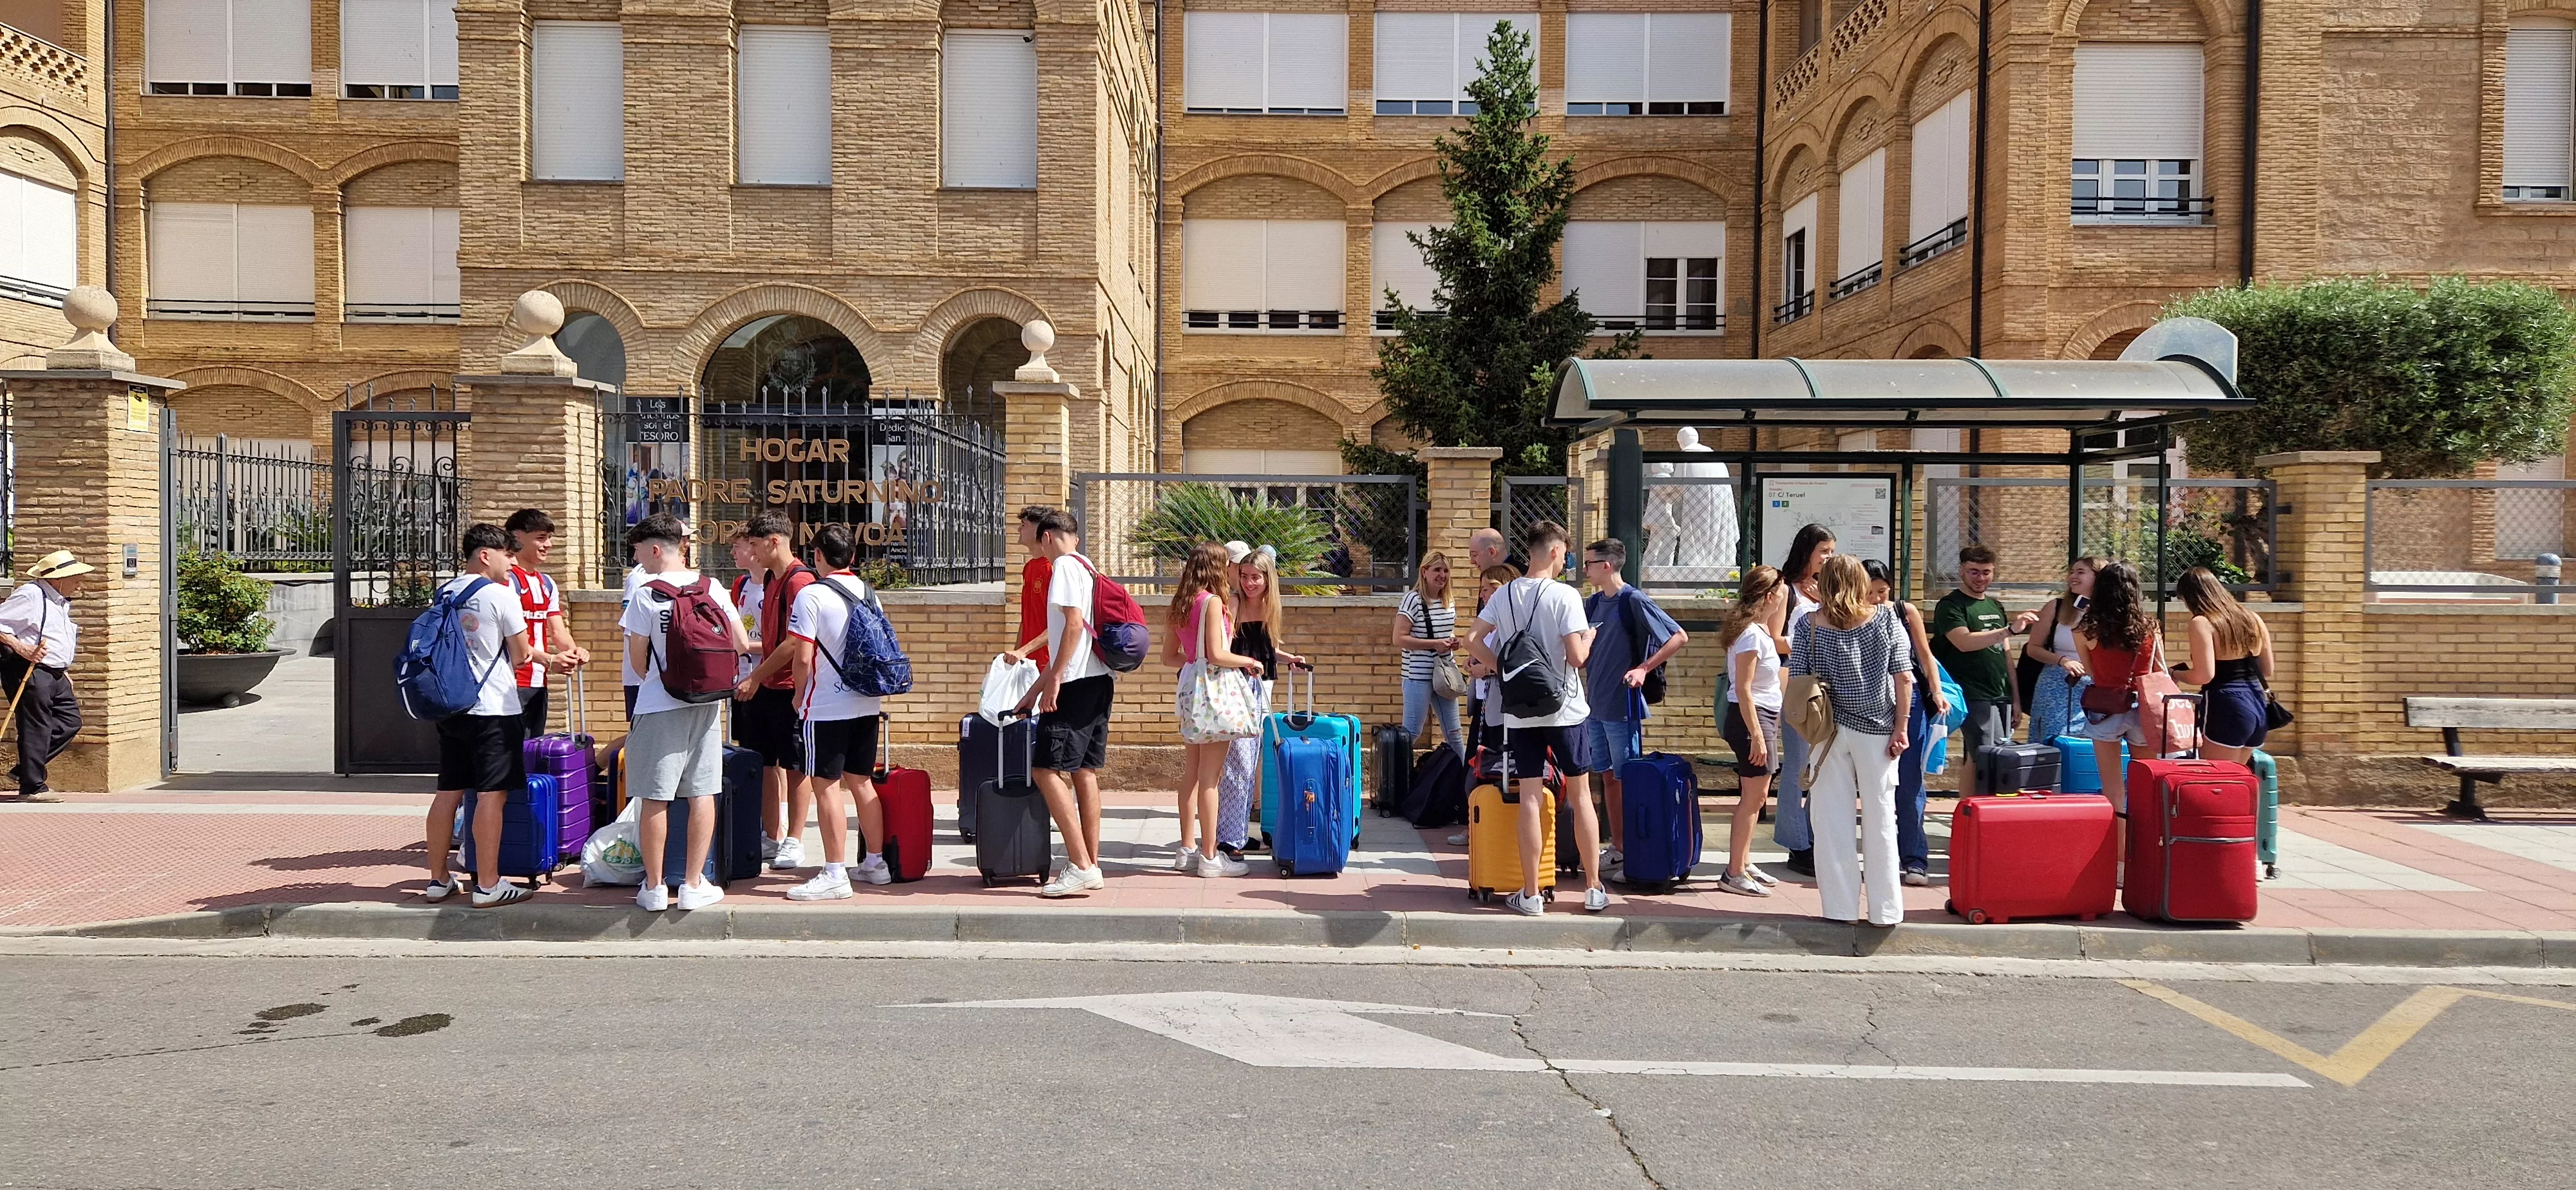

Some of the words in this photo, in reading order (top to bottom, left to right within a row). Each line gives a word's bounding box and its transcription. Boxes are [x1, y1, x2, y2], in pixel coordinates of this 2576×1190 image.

[663, 419, 672, 430] el
[740, 437, 850, 463] HOGAR
[649, 478, 752, 504] PADRE
[767, 479, 943, 505] SATURNINO
[799, 521, 904, 546] NVOA
